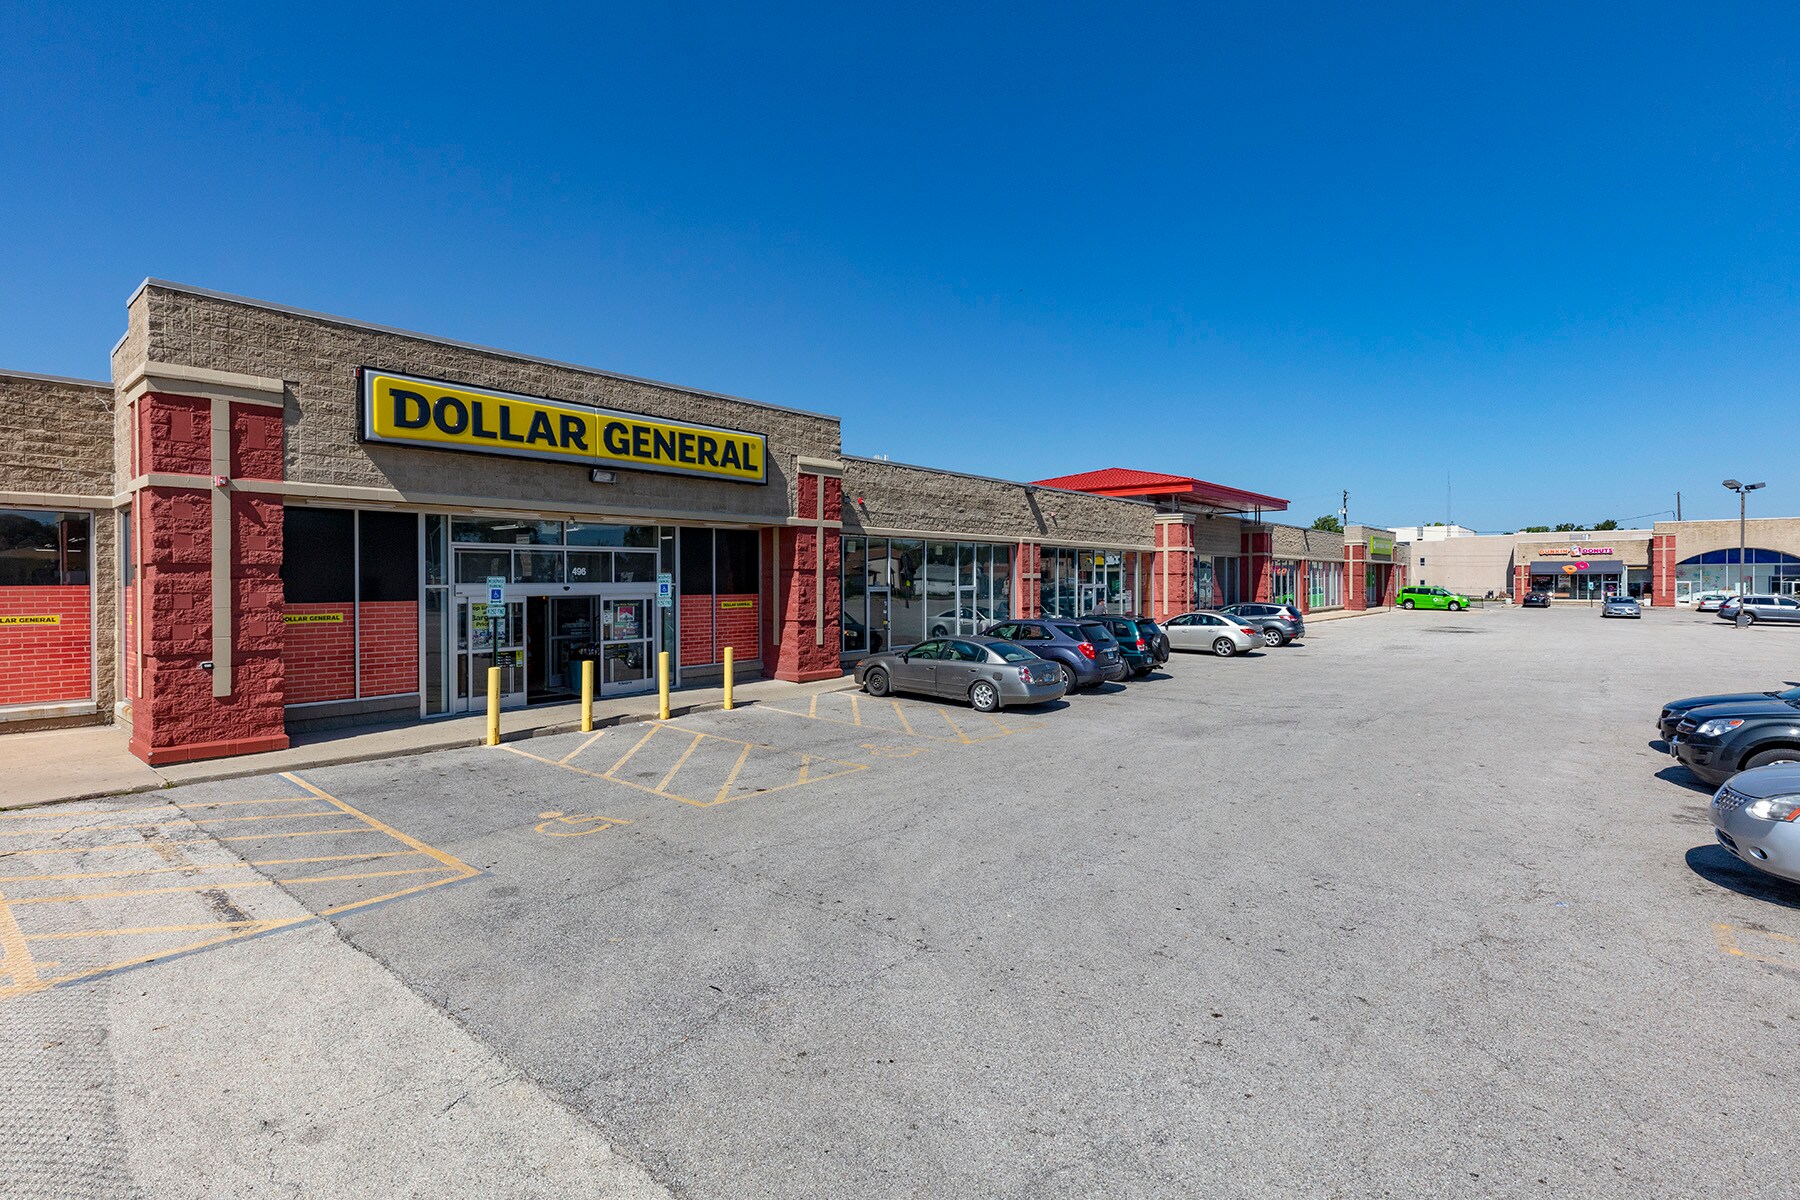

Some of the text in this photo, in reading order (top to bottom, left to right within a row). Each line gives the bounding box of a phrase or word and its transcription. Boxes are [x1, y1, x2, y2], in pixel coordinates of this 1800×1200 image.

[388, 387, 758, 472] DOLLAR GENERAL
[1582, 547, 1613, 555] DONUTS
[571, 567, 587, 576] 496
